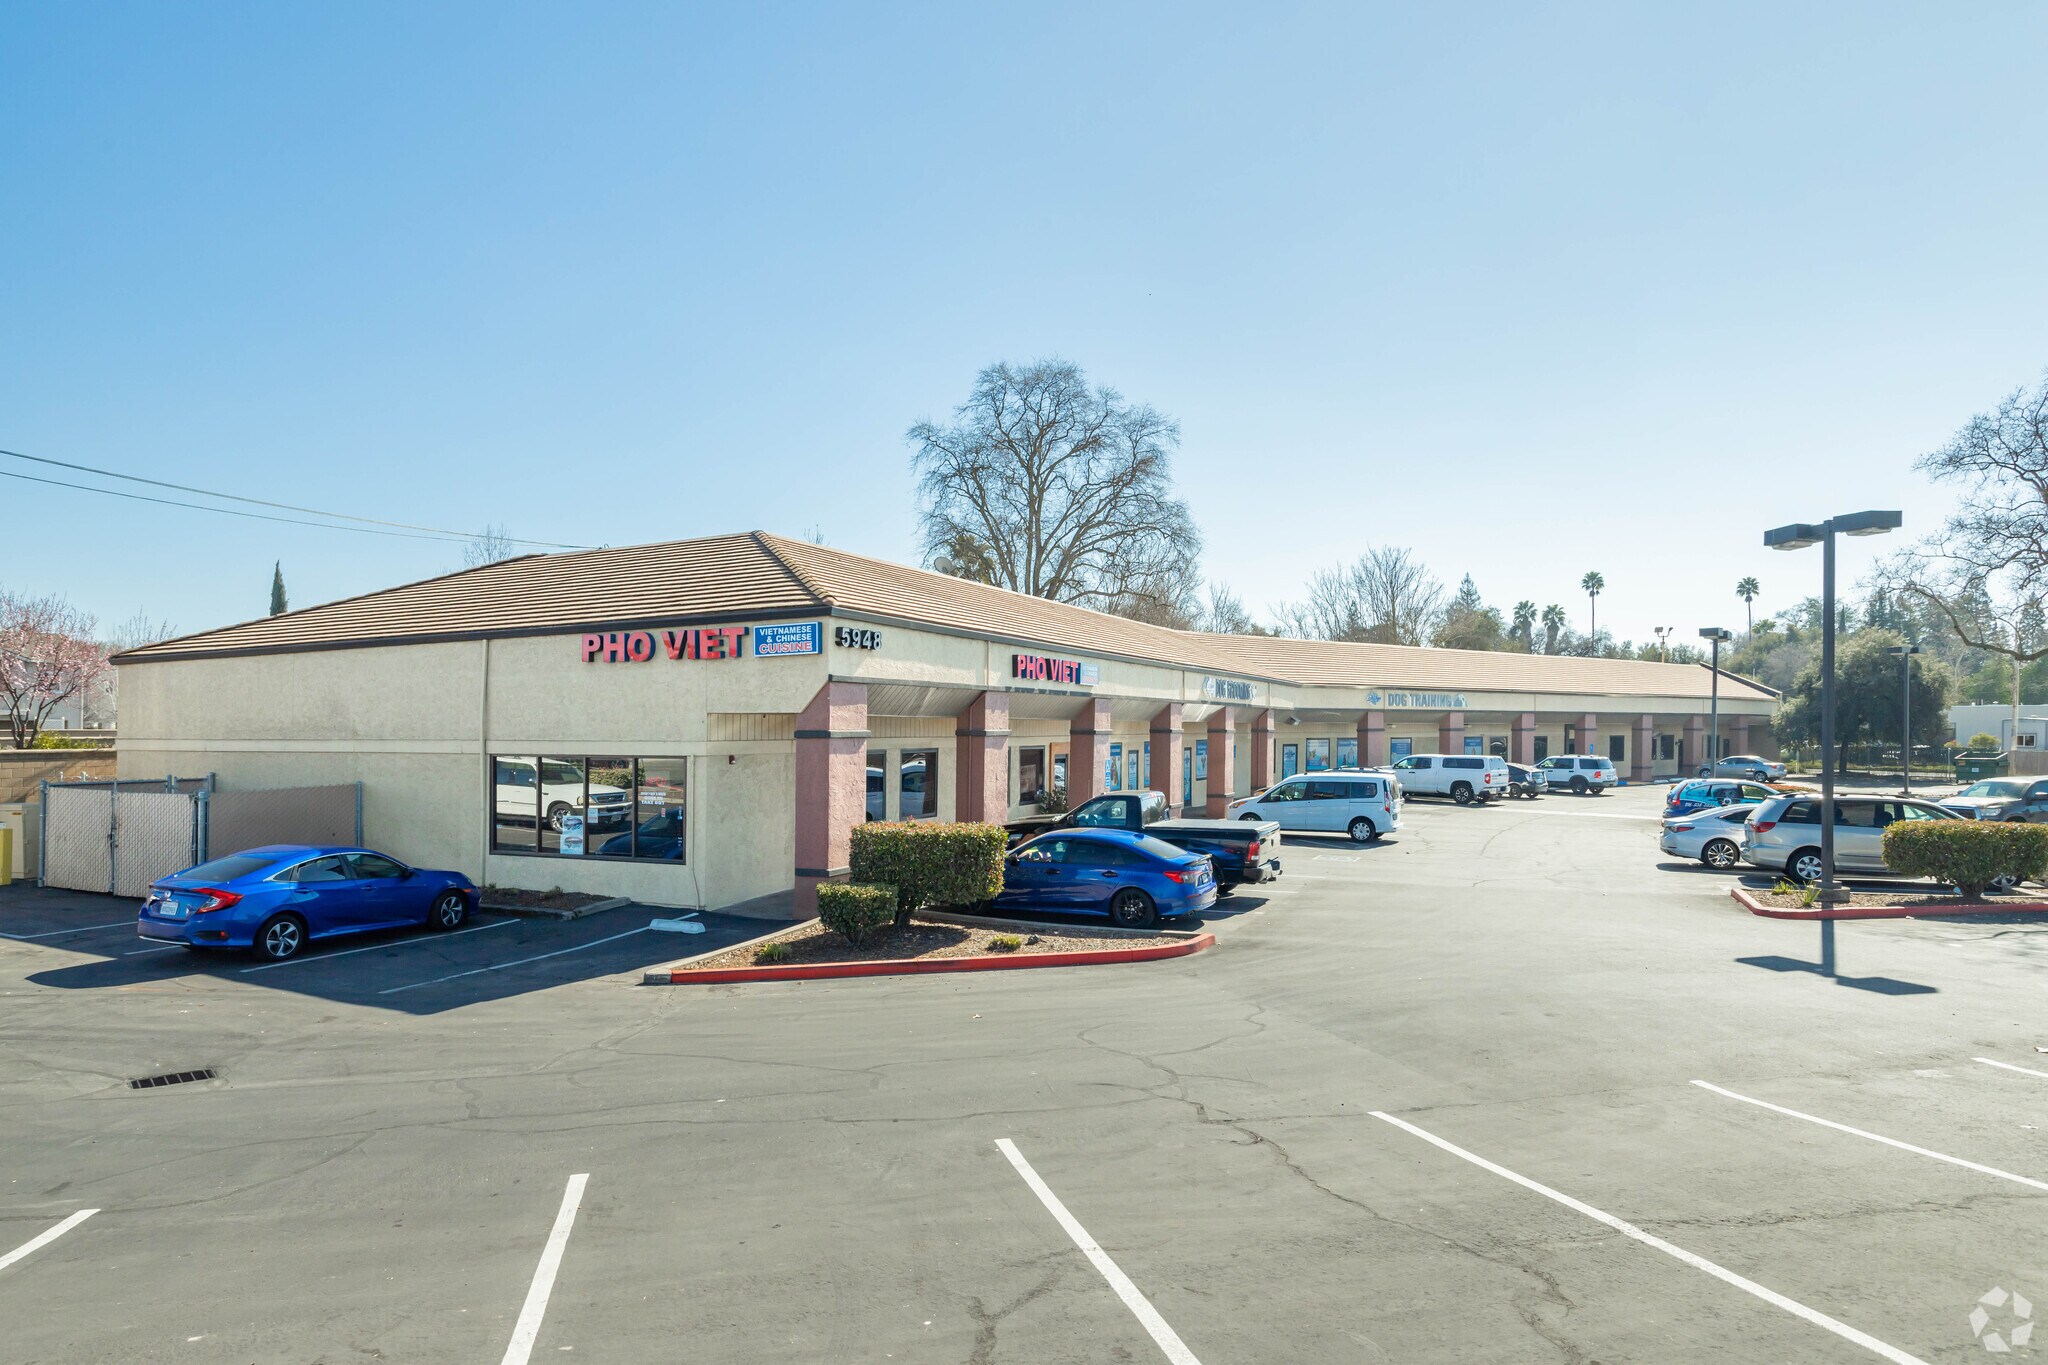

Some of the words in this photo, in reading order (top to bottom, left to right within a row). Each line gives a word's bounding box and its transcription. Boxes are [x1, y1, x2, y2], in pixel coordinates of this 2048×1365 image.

[759, 625, 812, 636] VIETNAMESE
[775, 633, 812, 642] CHINESE
[581, 631, 654, 663] PHO
[661, 626, 747, 660] VIET
[841, 627, 883, 650] 5948
[759, 640, 813, 654] CUISINE
[1016, 654, 1047, 681] PHO
[1049, 658, 1079, 683] VIET
[1387, 693, 1407, 707] DOG
[1409, 693, 1452, 708] TRAINING
